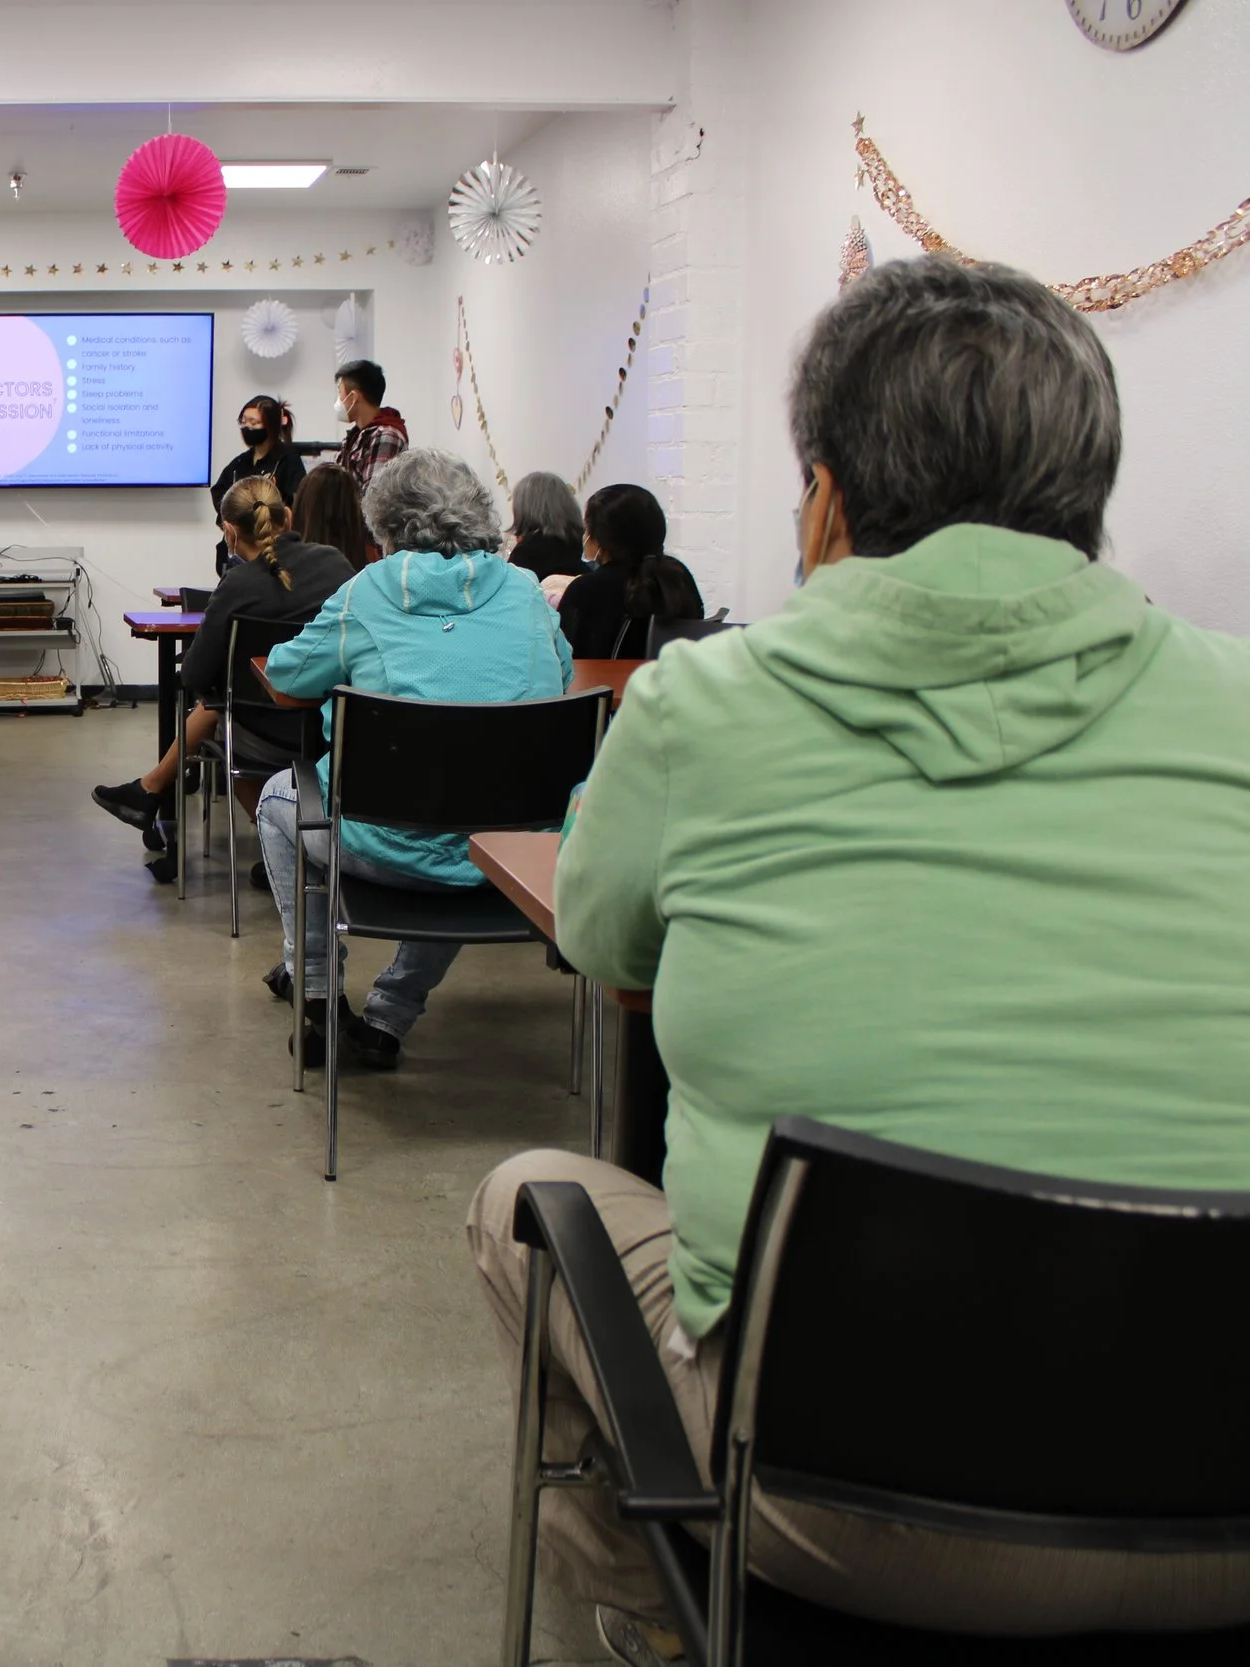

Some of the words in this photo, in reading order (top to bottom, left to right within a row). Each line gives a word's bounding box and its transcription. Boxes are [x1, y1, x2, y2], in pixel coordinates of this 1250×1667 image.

[81, 335, 113, 344] Medical
[160, 335, 179, 344] such
[81, 350, 109, 358] cancer
[111, 350, 120, 358] or
[122, 349, 147, 358] stroke
[81, 363, 107, 372] Family
[109, 363, 136, 373] history
[81, 376, 106, 385] Stress
[81, 390, 104, 399] Sleep
[105, 389, 144, 398] problems
[81, 403, 106, 411] Social
[107, 403, 141, 411] isolation
[142, 403, 159, 411] and
[81, 416, 120, 425] loneliness
[81, 429, 122, 438] Functional
[123, 429, 164, 438] limitations
[81, 443, 99, 451] Lack
[101, 443, 109, 451] of
[111, 443, 144, 452] physical
[145, 442, 174, 452] activity
